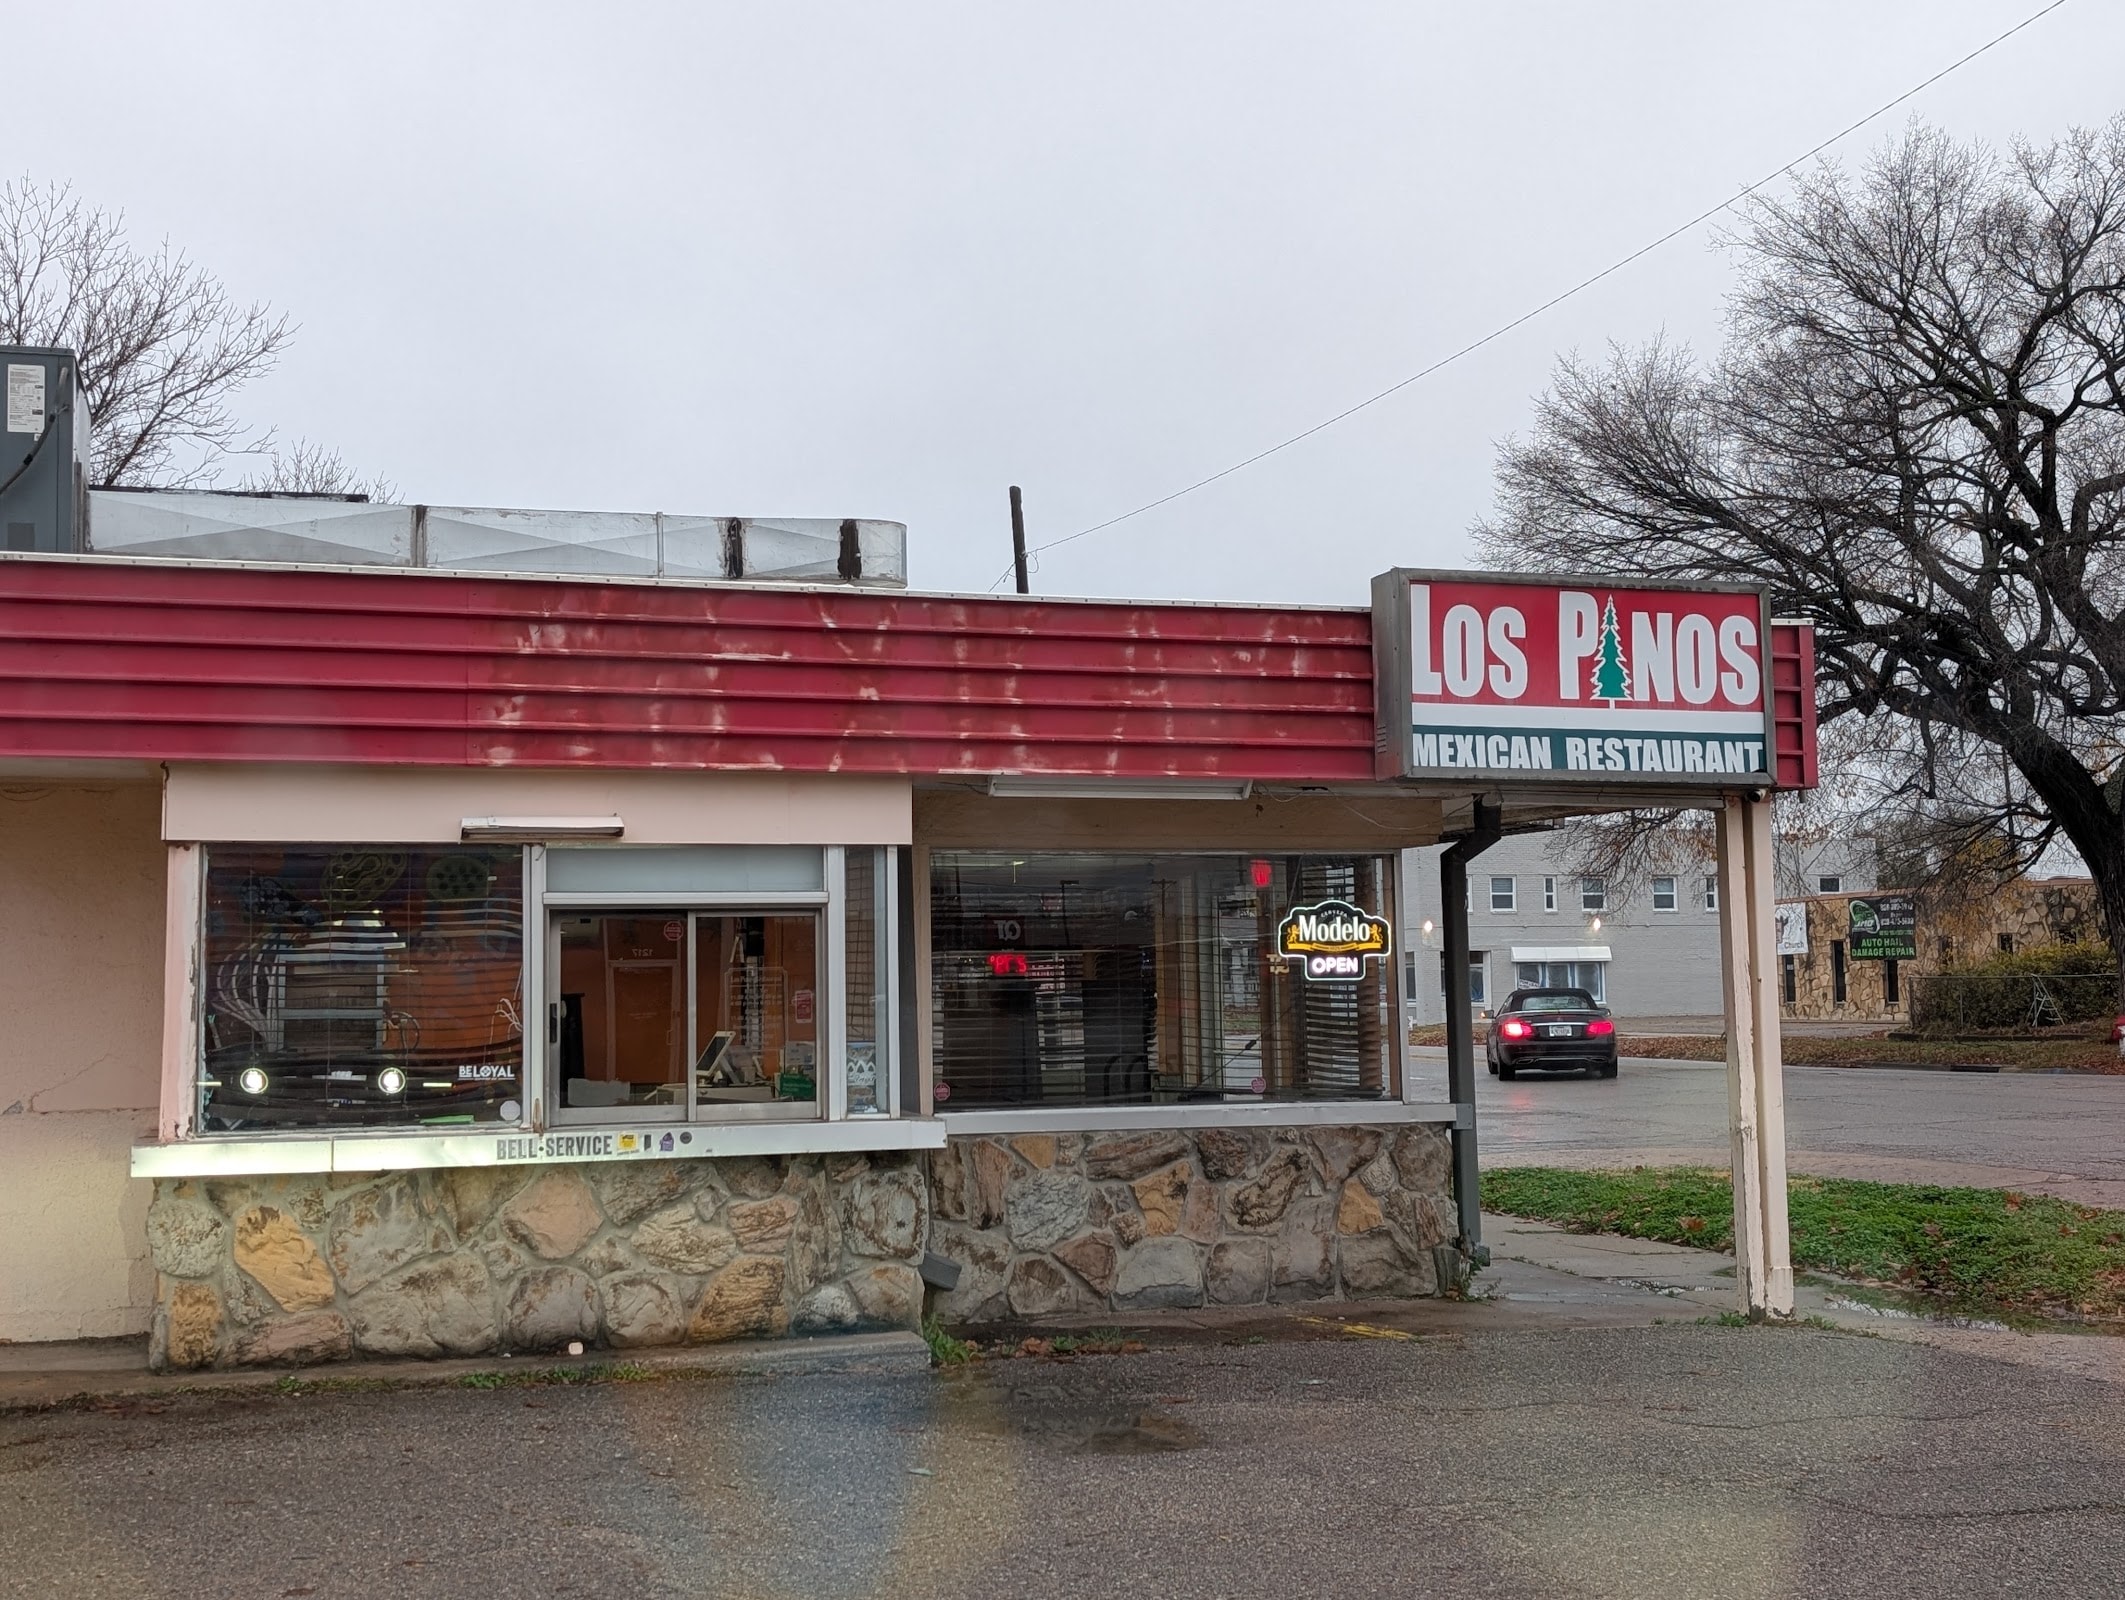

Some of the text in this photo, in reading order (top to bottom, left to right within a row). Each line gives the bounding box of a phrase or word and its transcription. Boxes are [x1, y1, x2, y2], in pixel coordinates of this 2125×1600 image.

[1411, 584, 1528, 699] LOS
[1413, 733, 1763, 773] MEXICAN RESTAURANT
[1299, 915, 1370, 942] Modelo
[1852, 947, 1915, 956] DAMAGE REPAIR
[1862, 938, 1903, 947] AUTO HAIL
[1311, 957, 1358, 973] OPEN
